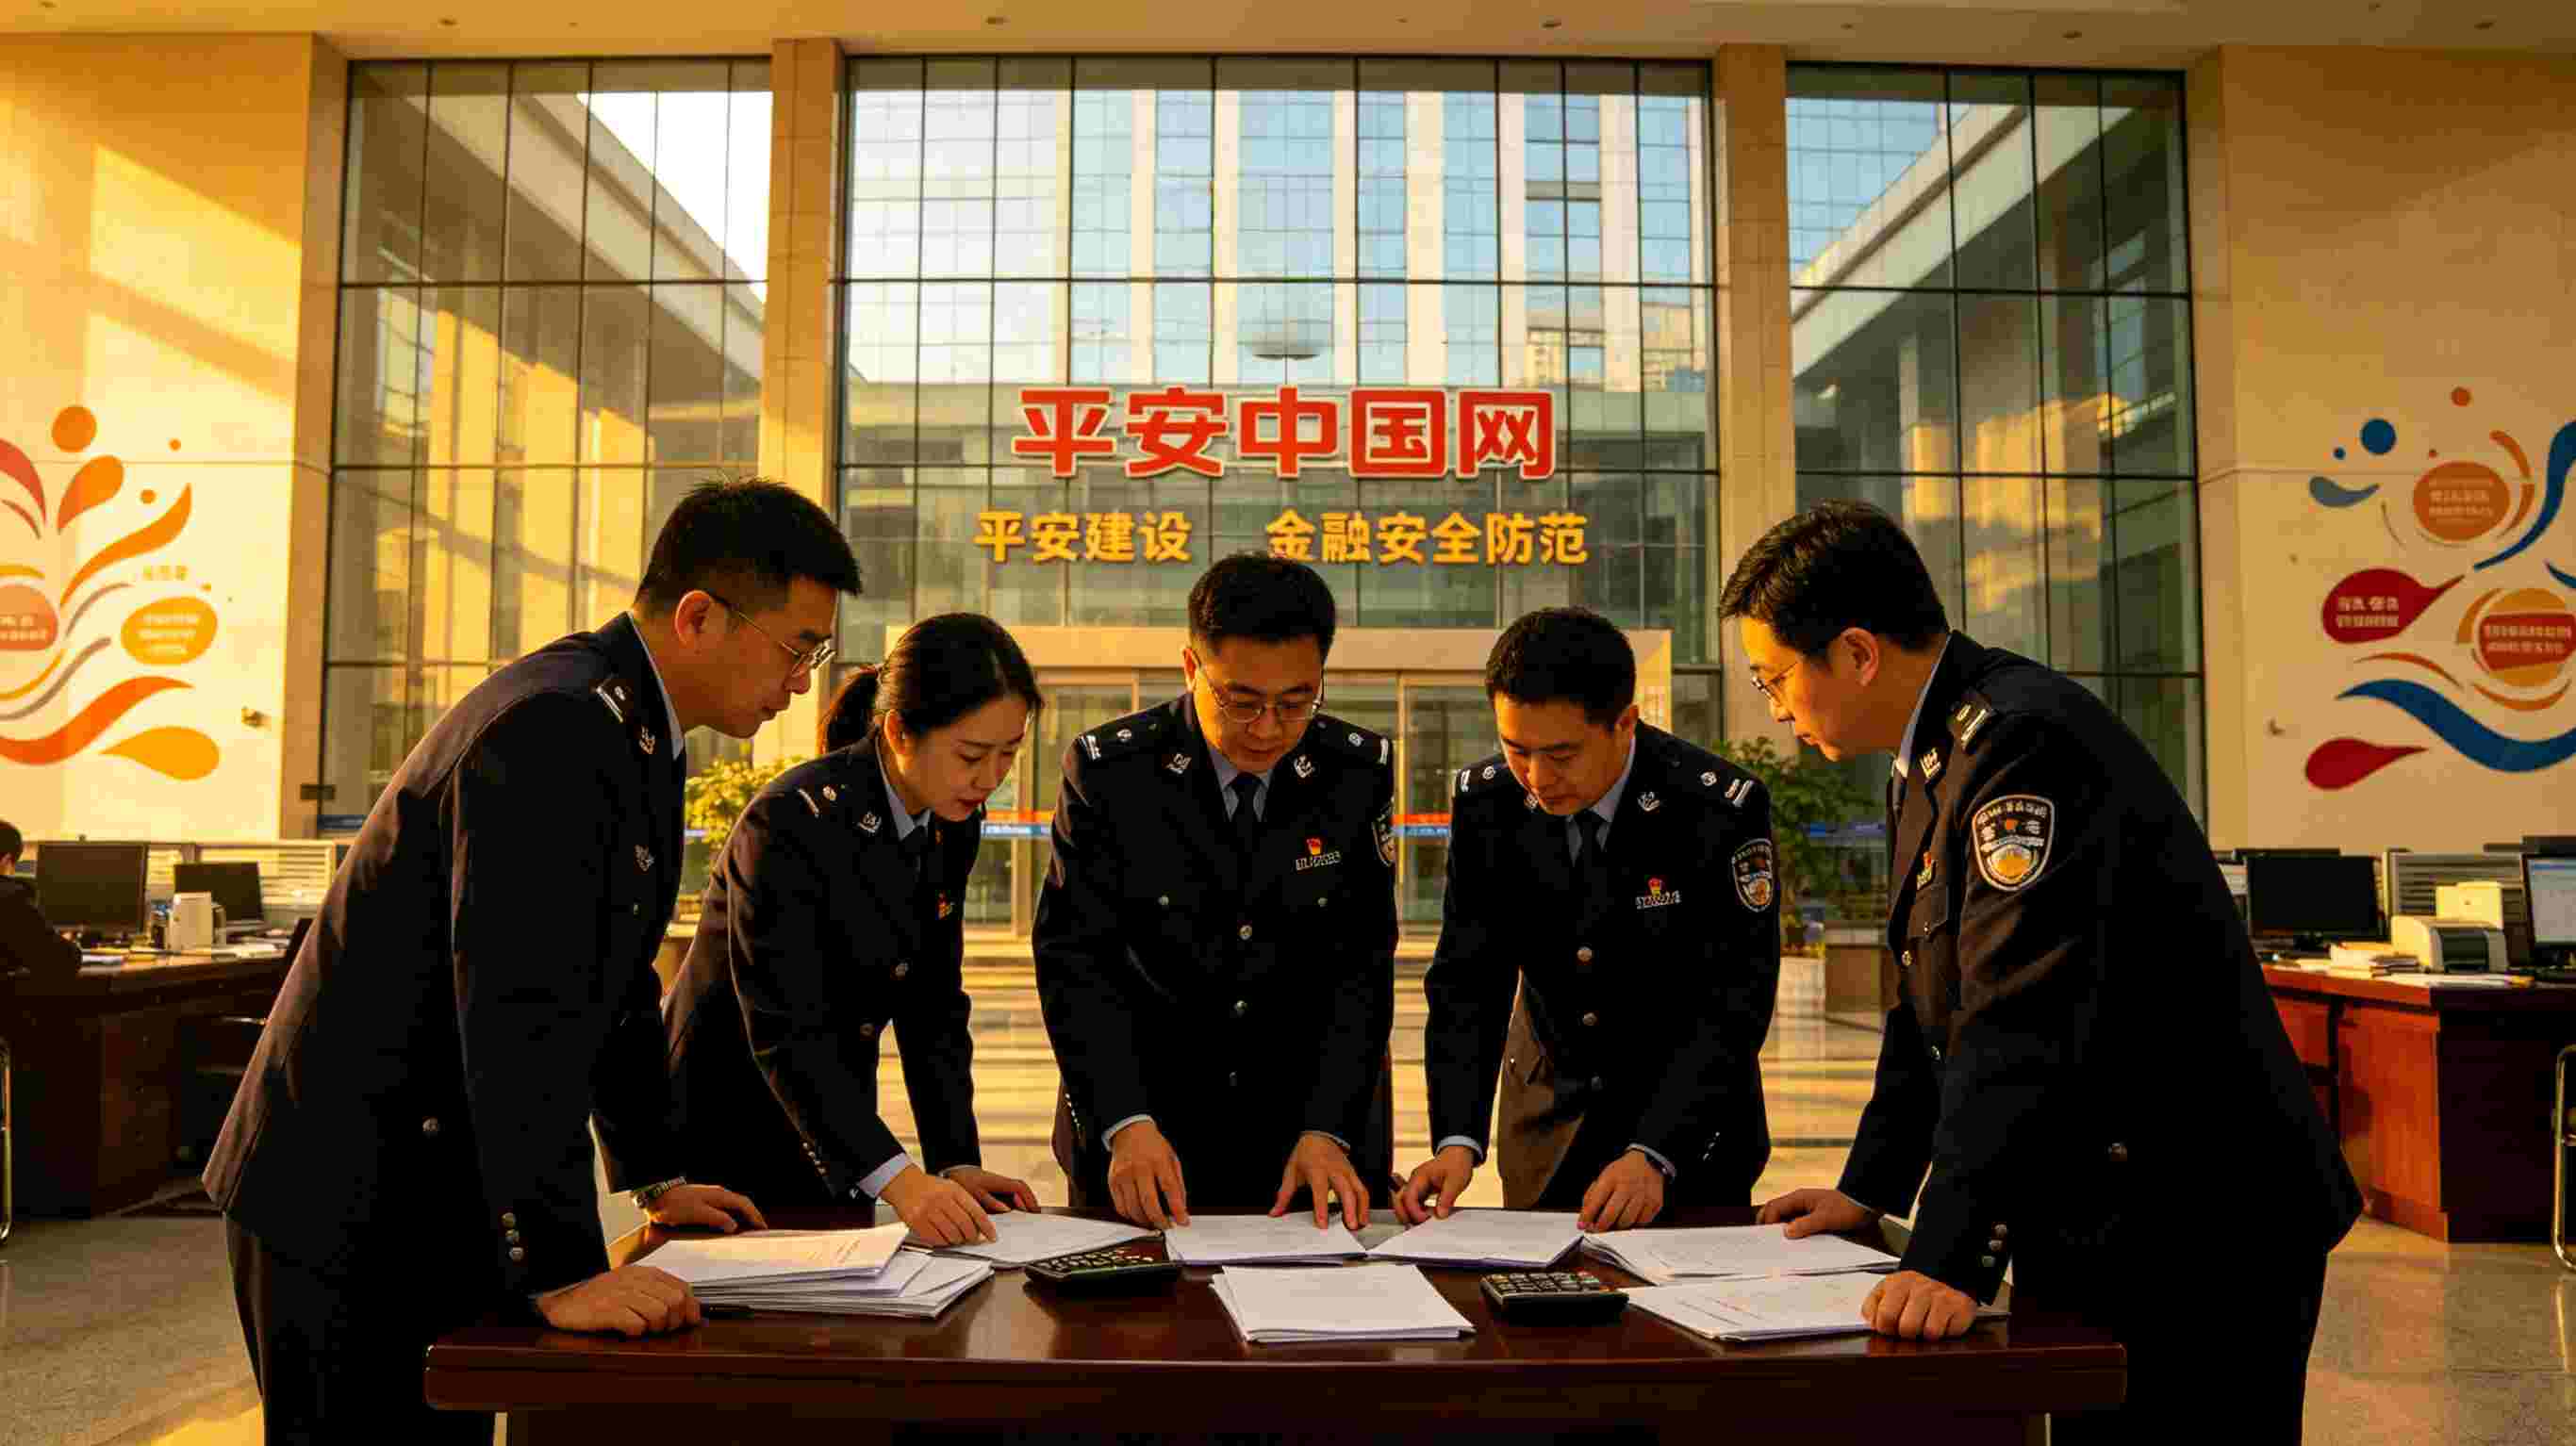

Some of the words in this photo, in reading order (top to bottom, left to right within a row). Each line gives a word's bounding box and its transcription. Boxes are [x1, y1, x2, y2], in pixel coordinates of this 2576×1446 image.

[1013, 386, 1556, 480] 平安中国网
[974, 510, 1193, 564] 平安建设
[1265, 508, 1590, 565] 金融安全防范
